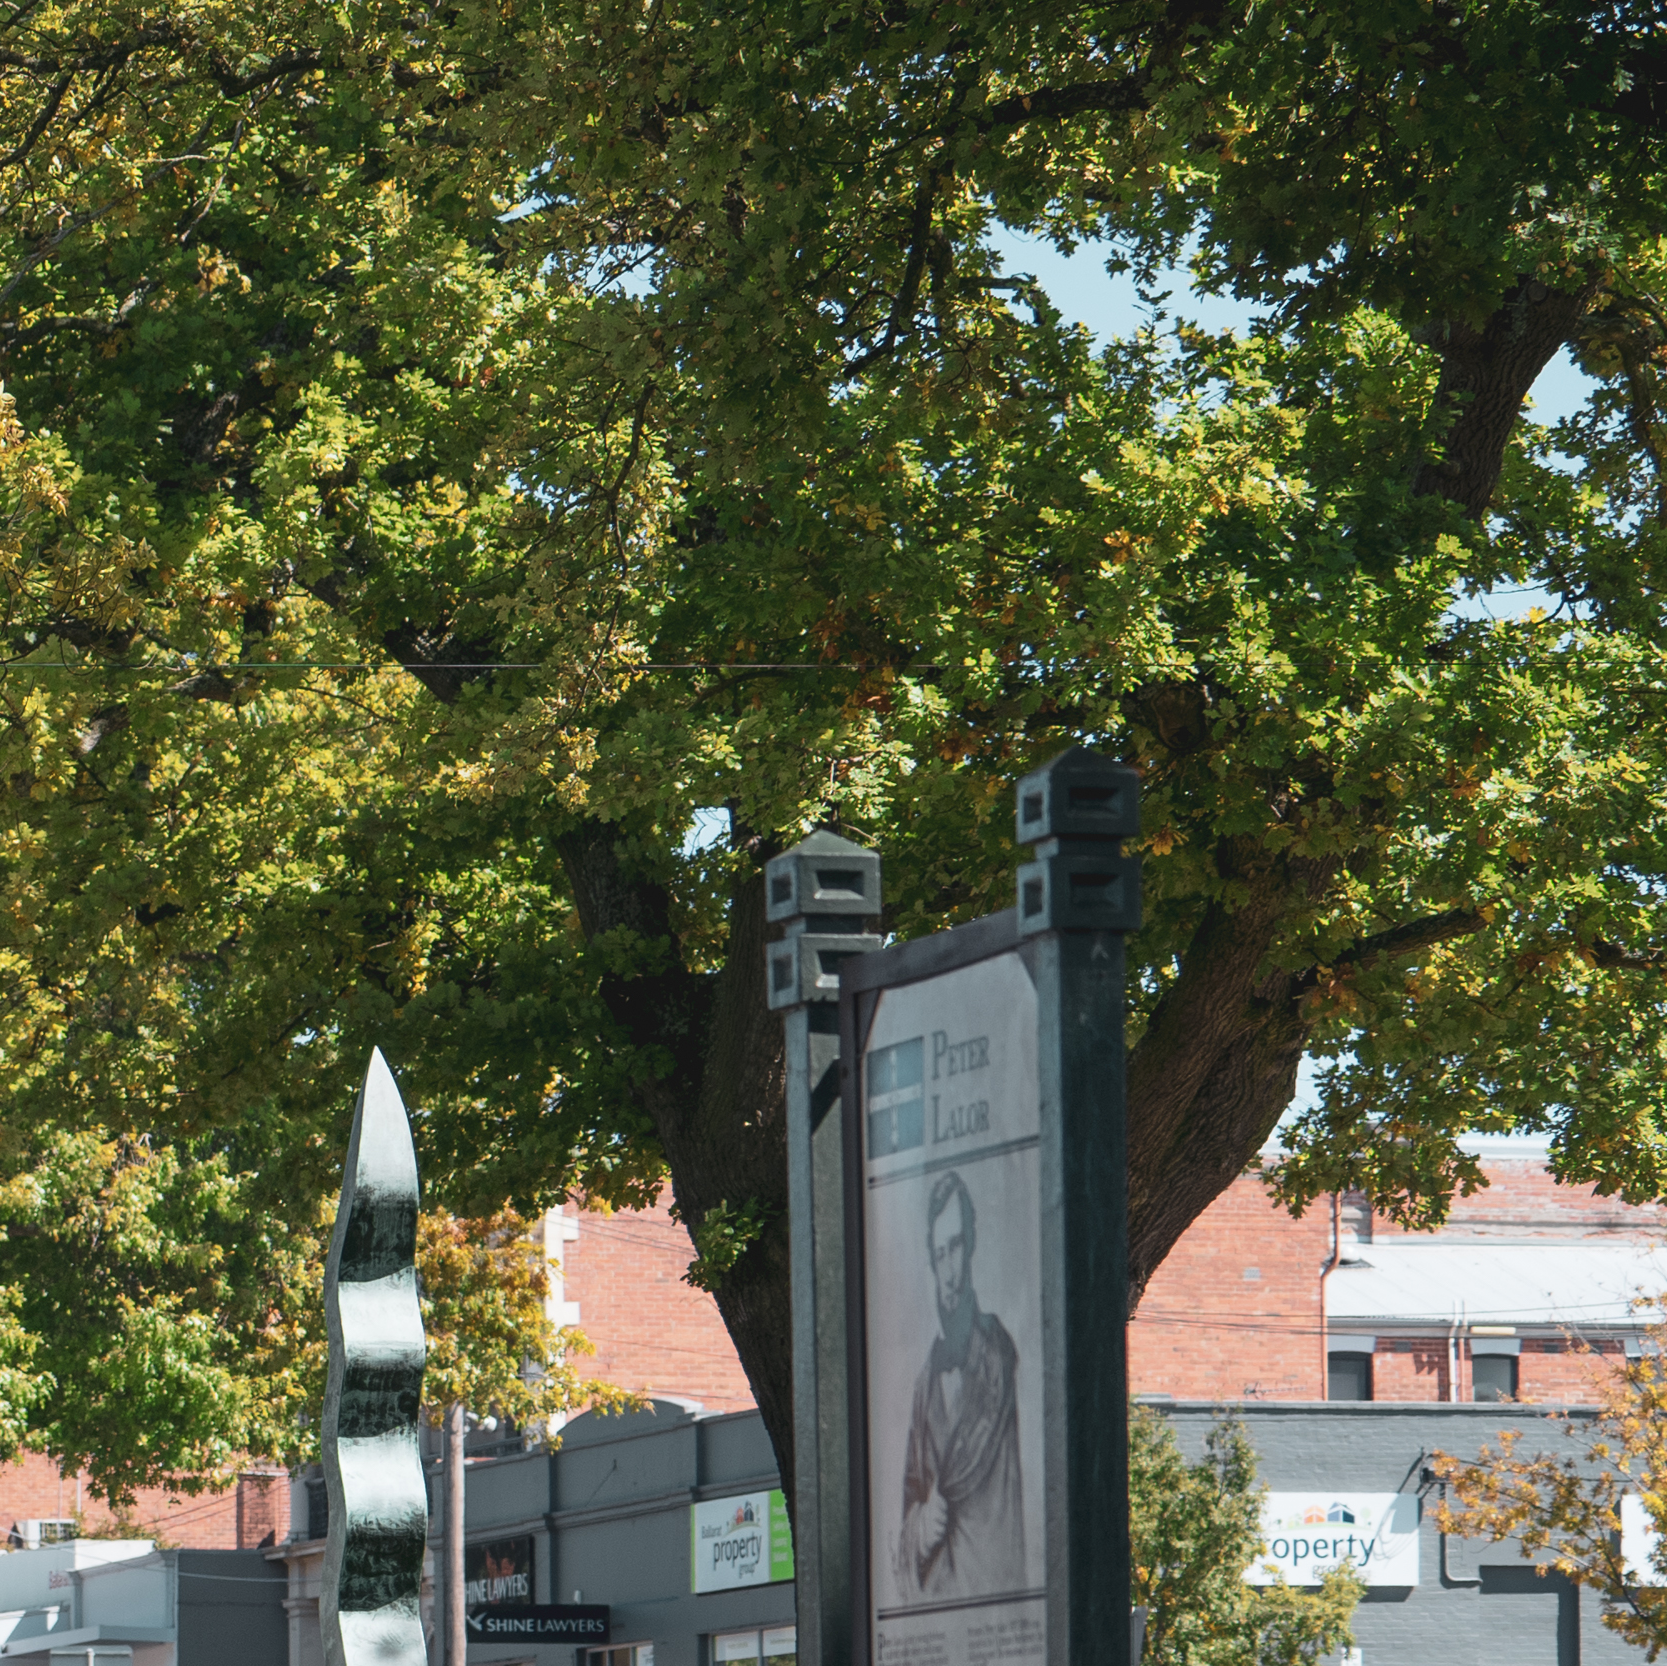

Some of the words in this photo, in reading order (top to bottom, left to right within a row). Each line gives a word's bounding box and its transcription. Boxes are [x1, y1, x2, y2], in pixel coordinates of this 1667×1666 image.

[931, 1029, 990, 1081] PETER
[932, 1094, 990, 1144] LALOR
[713, 1531, 762, 1571] property
[1268, 1534, 1375, 1566] operty
[465, 1579, 487, 1604] HINE
[487, 1572, 529, 1601] LAWYERS
[486, 1618, 534, 1632] SHINE
[537, 1618, 605, 1633] LAWYERS
